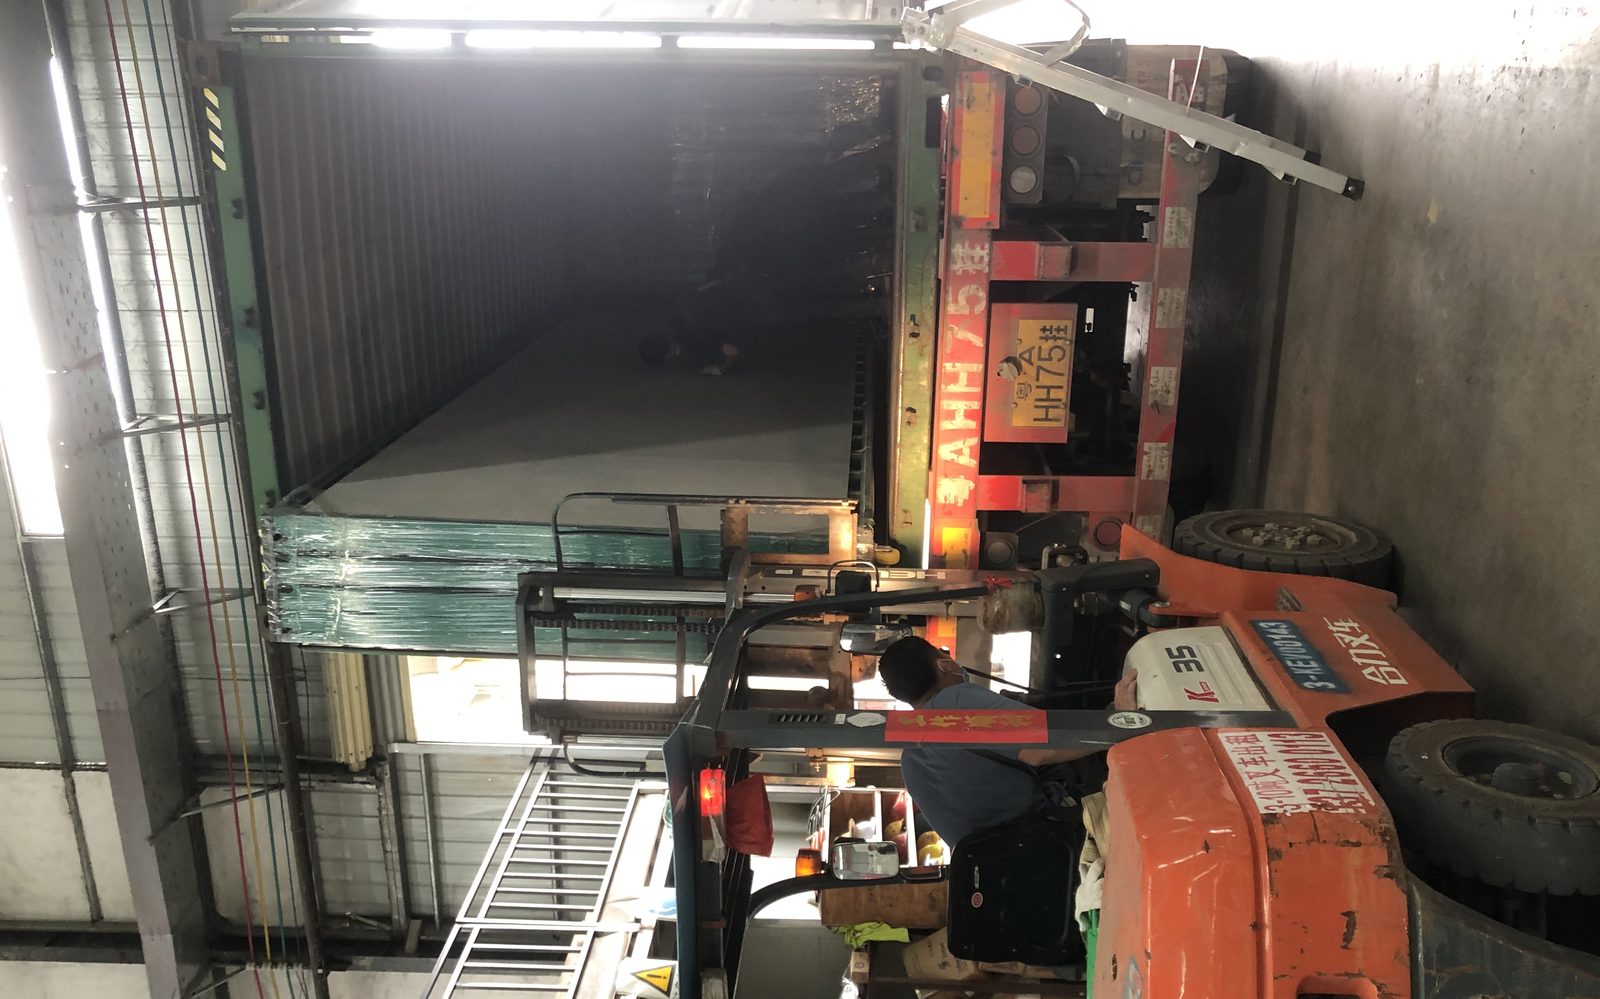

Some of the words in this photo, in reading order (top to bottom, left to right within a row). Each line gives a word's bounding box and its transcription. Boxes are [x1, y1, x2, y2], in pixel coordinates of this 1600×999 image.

[1033, 325, 1068, 422] HH75挂
[1165, 645, 1205, 673] 35
[1323, 617, 1408, 686] 合力叉车
